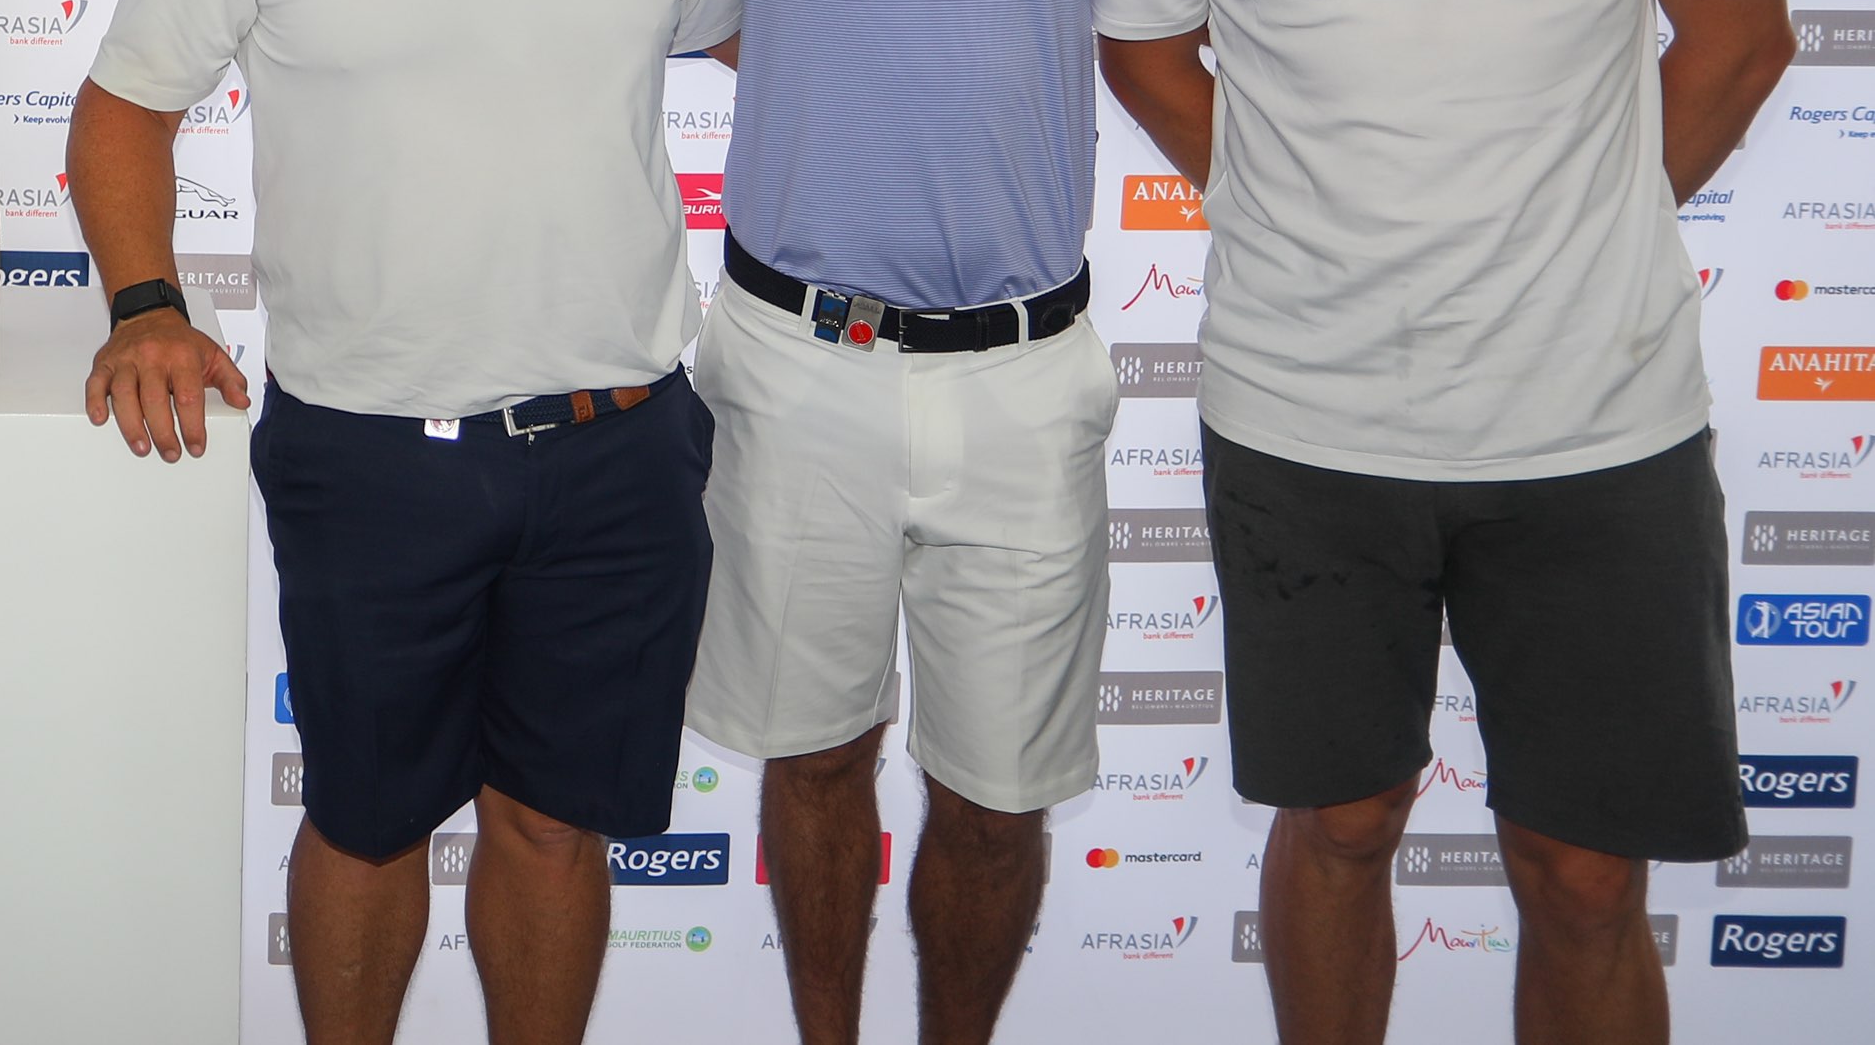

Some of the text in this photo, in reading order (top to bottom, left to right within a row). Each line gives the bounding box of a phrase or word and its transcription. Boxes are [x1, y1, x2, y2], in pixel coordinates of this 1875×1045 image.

[31, 37, 62, 45] different
[1783, 601, 1863, 621] ASIAN
[1788, 618, 1858, 640] TOUR
[1738, 764, 1849, 798] Rogers
[605, 843, 721, 877] Rogers
[1125, 852, 1201, 862] mastercard
[1761, 854, 1842, 865] HERITAGE
[630, 941, 681, 949] FEDERATION
[1081, 934, 1173, 949] AFRASIA
[1720, 924, 1837, 958] Rogers
